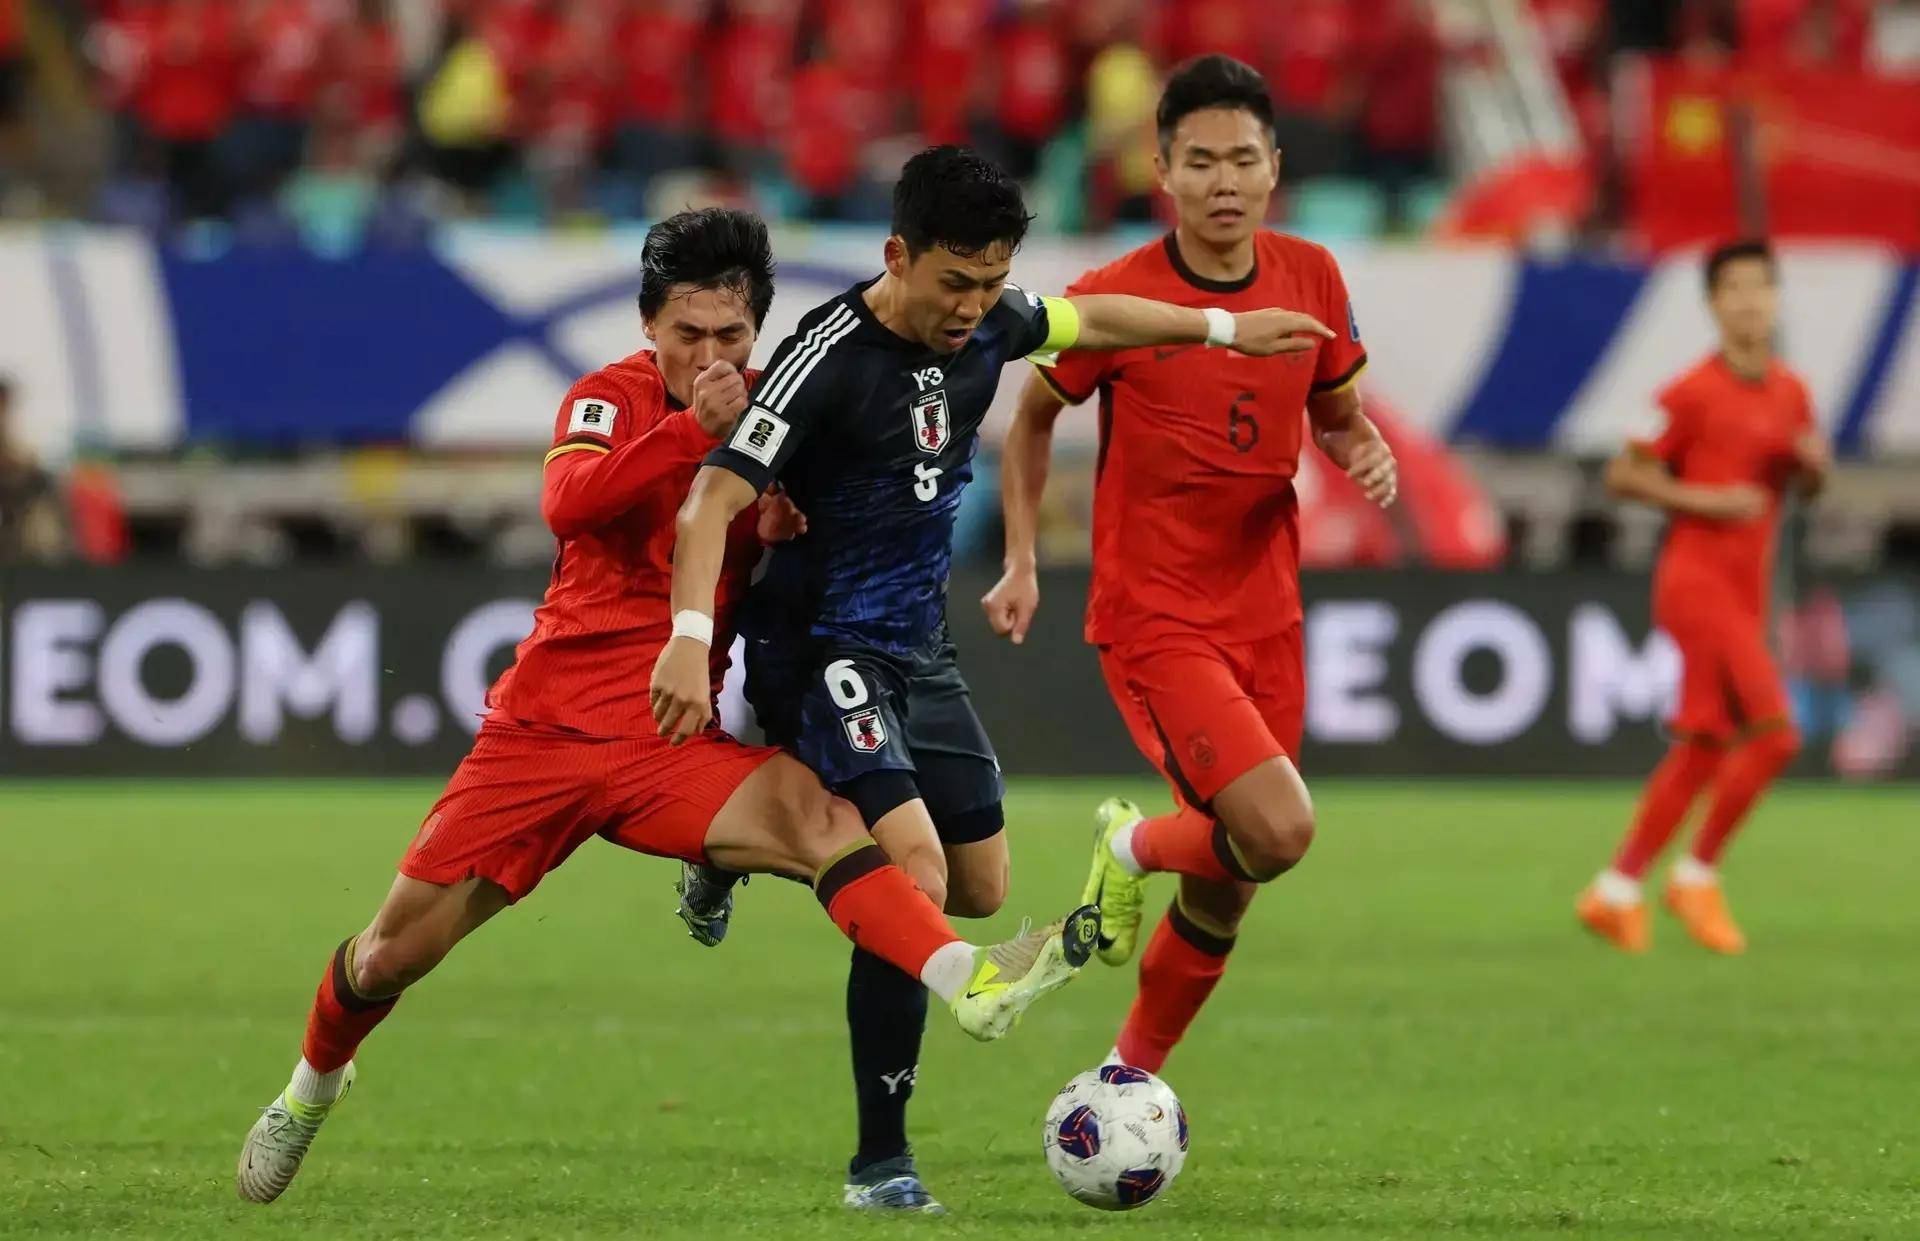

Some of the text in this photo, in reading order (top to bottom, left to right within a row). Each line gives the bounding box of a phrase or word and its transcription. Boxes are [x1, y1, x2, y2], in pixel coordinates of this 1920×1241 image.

[912, 367, 944, 391] Y-3
[1230, 391, 1259, 453] 6
[824, 659, 868, 710] 6
[1304, 597, 1684, 746] EOM
